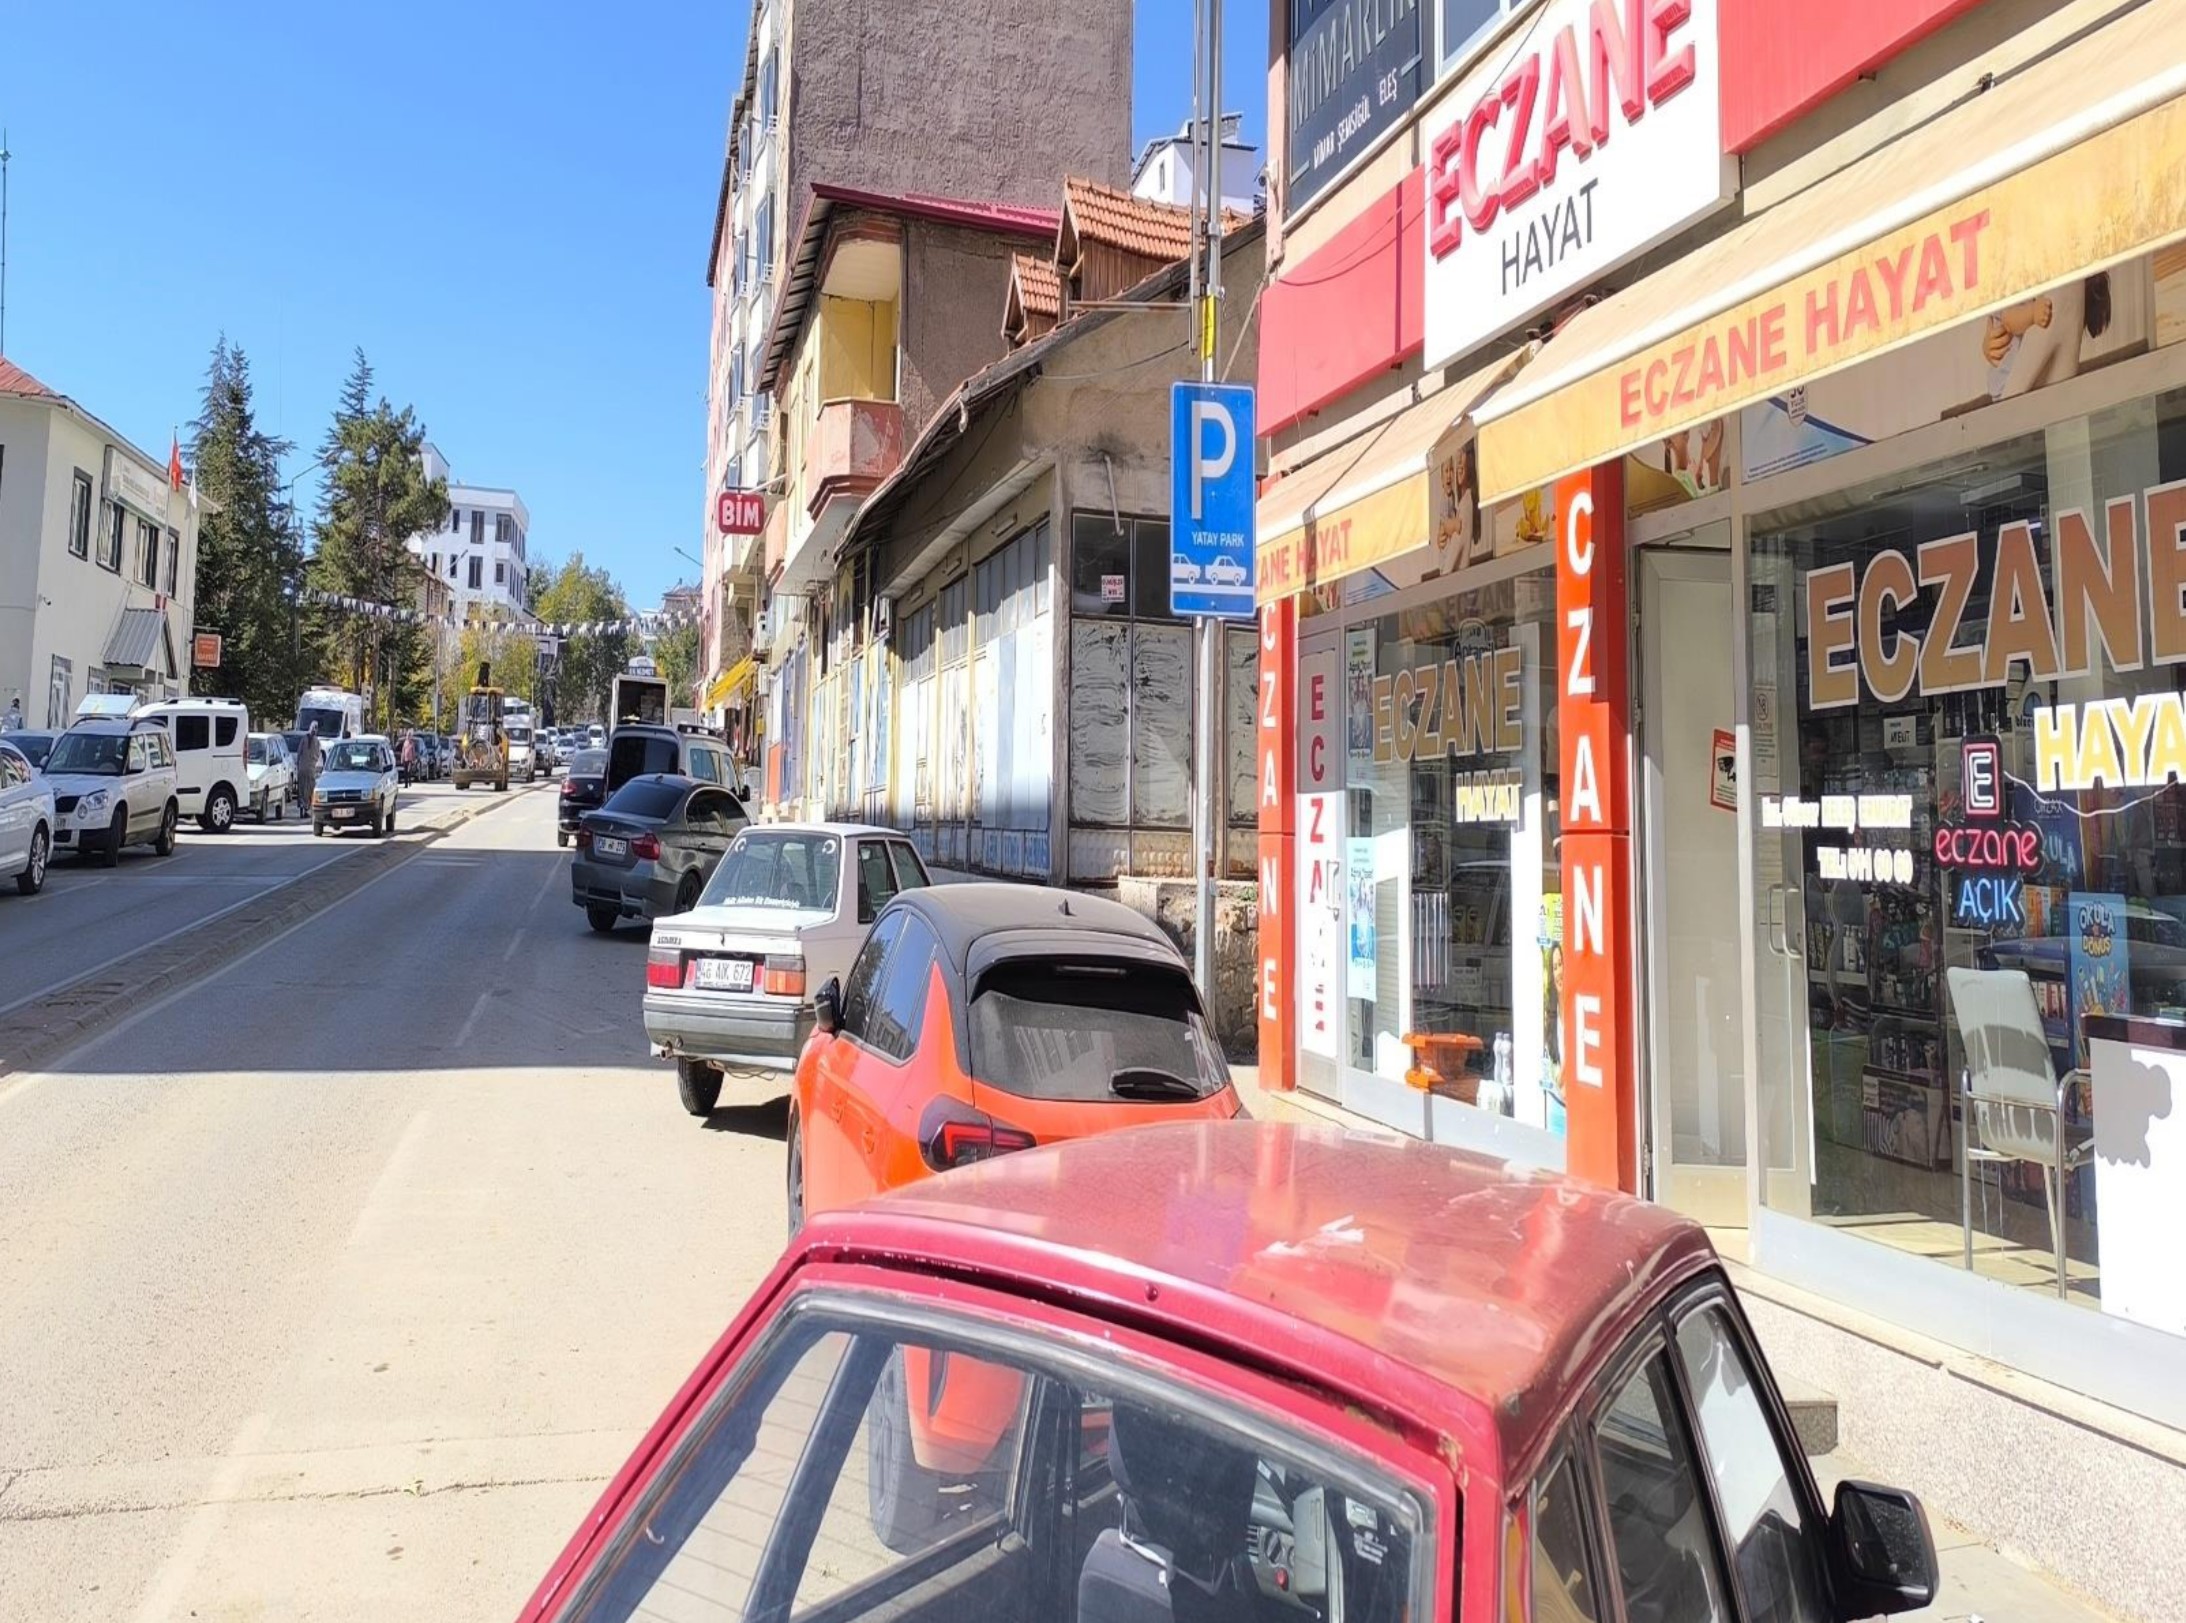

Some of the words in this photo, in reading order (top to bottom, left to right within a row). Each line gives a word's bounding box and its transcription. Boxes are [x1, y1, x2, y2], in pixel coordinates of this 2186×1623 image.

[1430, 0, 1696, 263] ECZANE
[1502, 178, 1599, 297] HAYAT
[1620, 302, 1787, 429] ECZANE
[1805, 207, 1990, 355] HAYAT
[1190, 400, 1237, 520] P
[722, 494, 760, 528] BİM
[1191, 531, 1218, 547] YATAY
[1220, 532, 1245, 548] PARK
[1806, 479, 2186, 711] ECZANE
[1372, 645, 1523, 766] ECZANE
[1456, 767, 1524, 823] HAYAT
[1935, 828, 2039, 867] eczane
[1958, 877, 2020, 923] AÇIK
[2079, 902, 2116, 933] OKULA
[733, 963, 751, 982] 672
